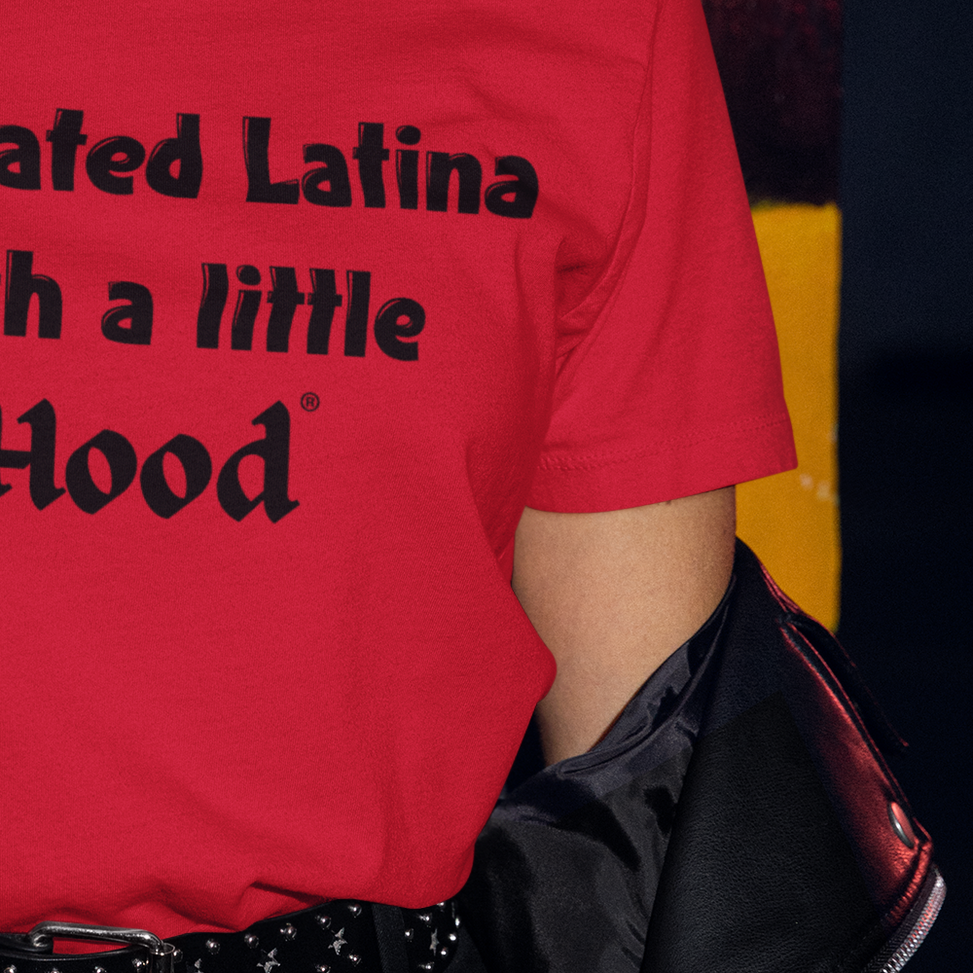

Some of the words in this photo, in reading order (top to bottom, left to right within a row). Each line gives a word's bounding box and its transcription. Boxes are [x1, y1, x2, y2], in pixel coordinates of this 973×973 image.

[242, 115, 540, 220] Latina
[100, 280, 154, 346] a
[196, 262, 427, 362] little
